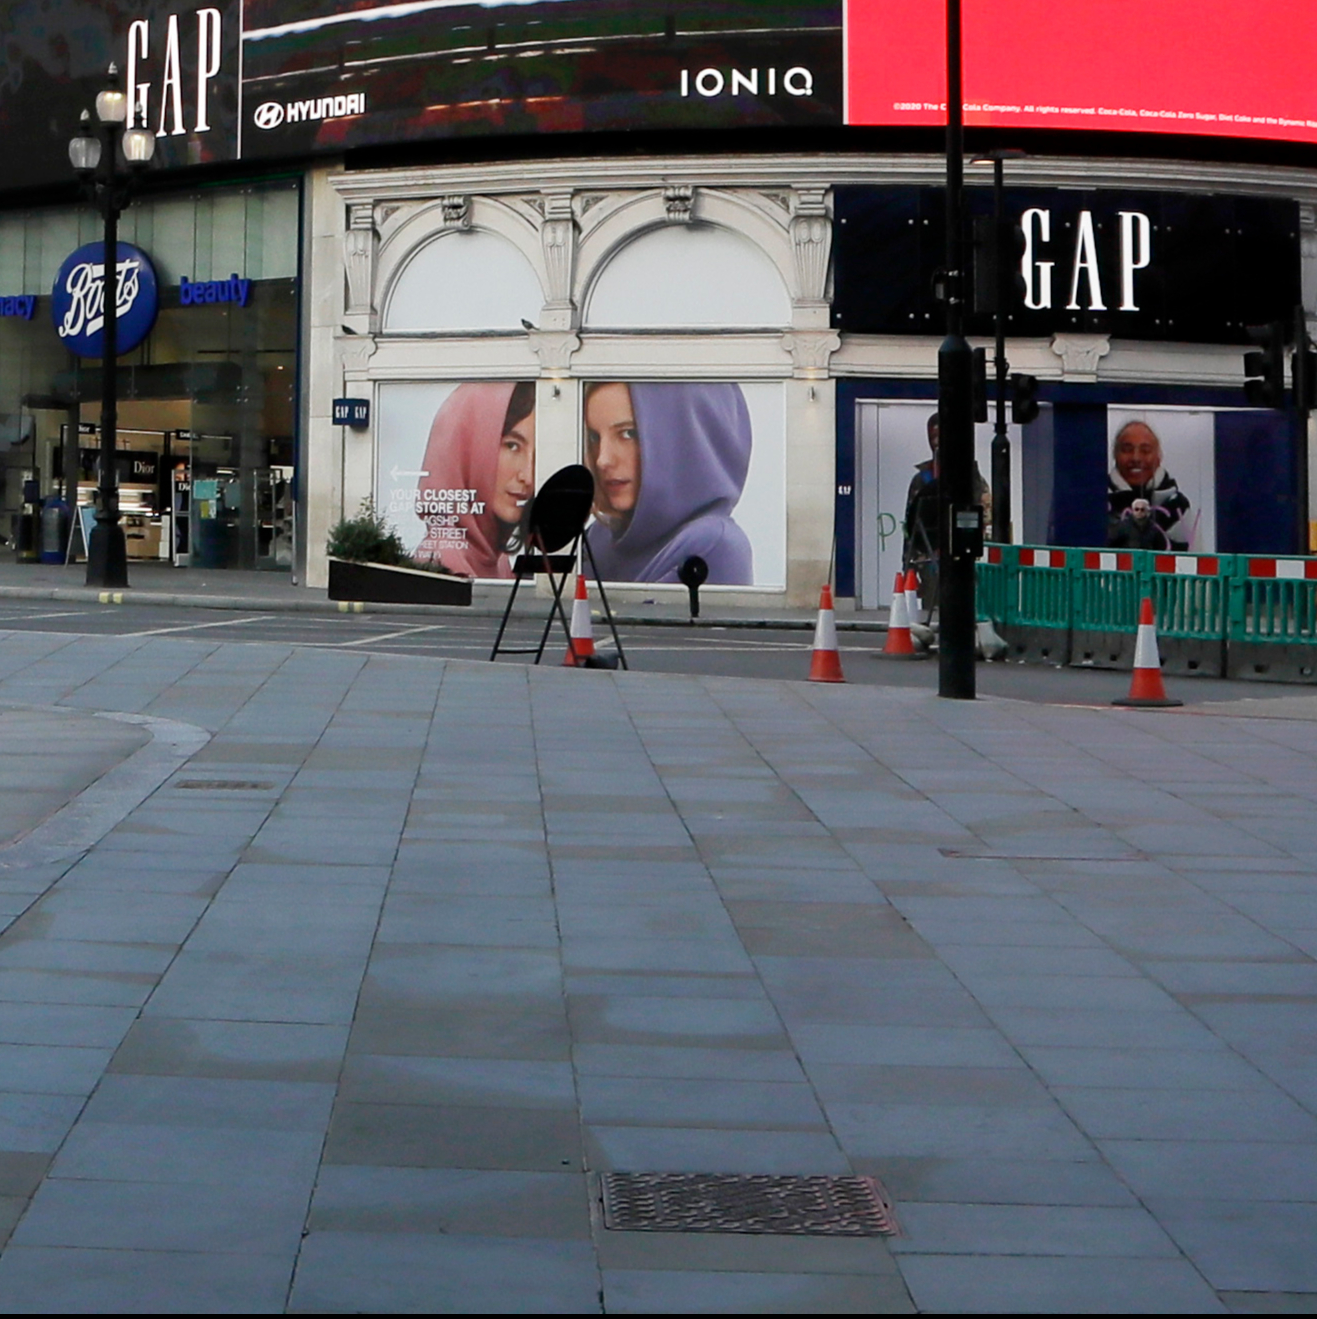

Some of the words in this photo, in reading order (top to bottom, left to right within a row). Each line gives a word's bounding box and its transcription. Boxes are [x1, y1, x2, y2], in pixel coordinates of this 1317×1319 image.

[126, 7, 222, 138] GAP
[680, 66, 814, 97] IONIQ
[286, 93, 365, 122] HYUNDAI
[923, 103, 939, 111] The
[982, 104, 1023, 113] Company.
[1024, 104, 1035, 113] All
[1036, 105, 1060, 115] rights
[1061, 107, 1096, 115] reserved.
[1178, 111, 1194, 119] Zero
[1252, 116, 1266, 124] and
[1020, 208, 1152, 312] GAP
[180, 273, 252, 308] beauty
[335, 406, 349, 418] GAP
[354, 406, 367, 419] GAP
[133, 461, 155, 474] Dior
[390, 490, 420, 501] YOUR
[424, 489, 477, 501] CLOSEST
[390, 502, 414, 513] GAP
[417, 502, 453, 514] STORE
[456, 502, 468, 514] IS
[470, 502, 485, 514] AT
[430, 528, 468, 539] STREET
